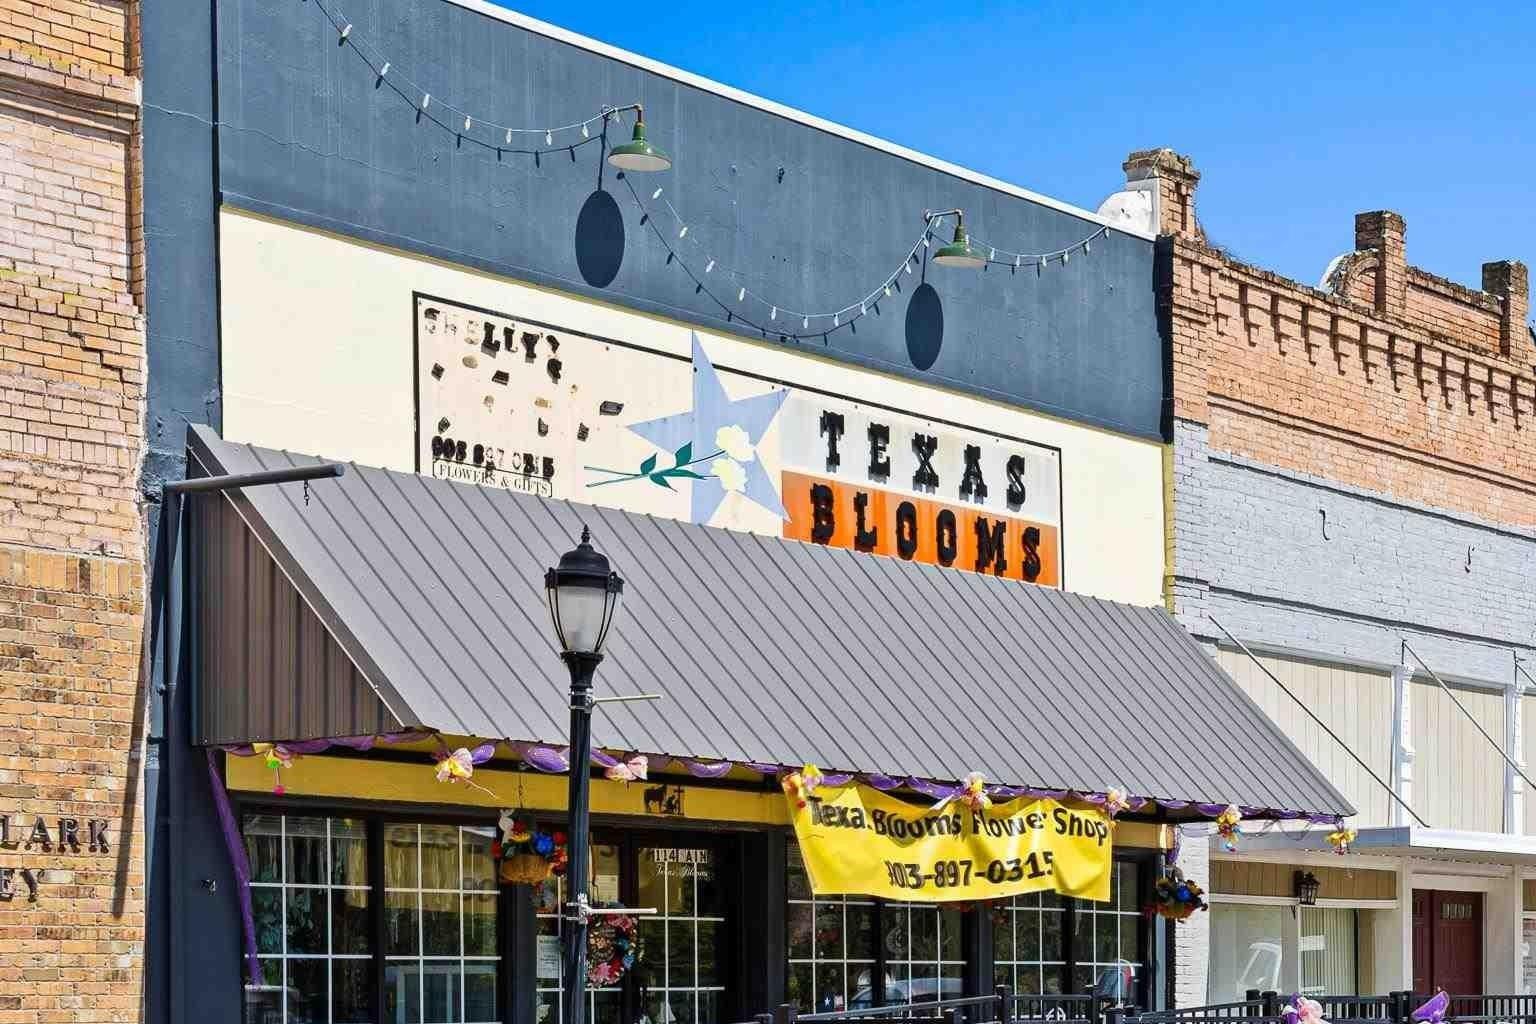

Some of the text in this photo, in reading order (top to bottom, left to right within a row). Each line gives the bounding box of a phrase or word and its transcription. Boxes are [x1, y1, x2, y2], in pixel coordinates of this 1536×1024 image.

[439, 463, 548, 494] FLOWERS & GIFTS
[820, 410, 1026, 512] TEXAS
[810, 483, 1041, 582] BLOOMS
[808, 796, 872, 829] Texa
[972, 809, 1047, 838] Flowe
[1053, 808, 1107, 846] Shop
